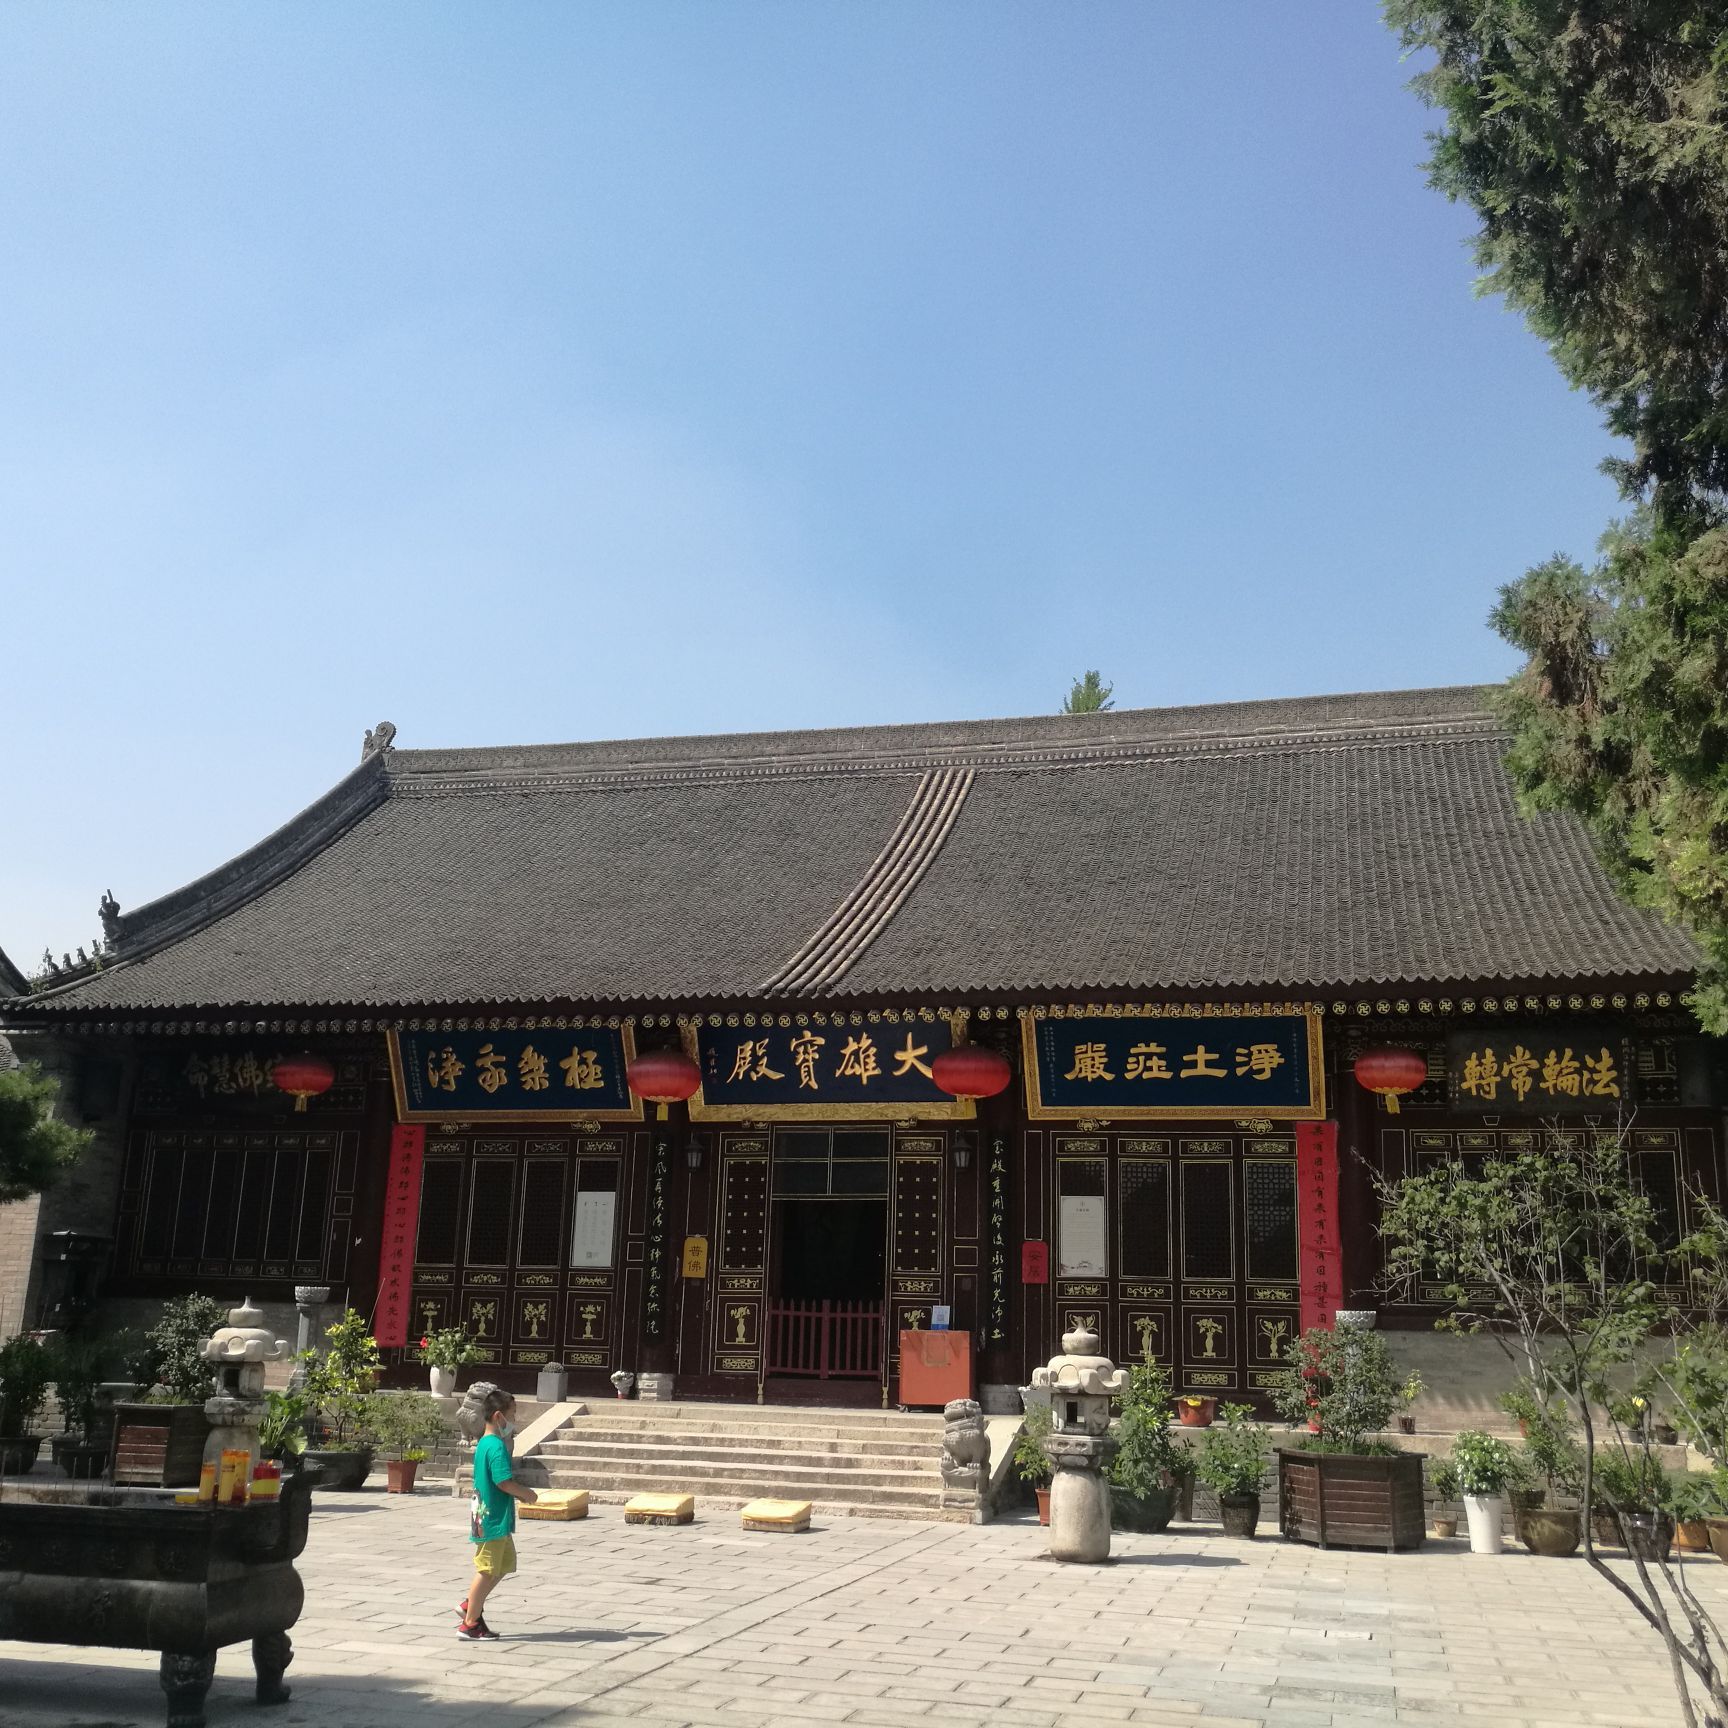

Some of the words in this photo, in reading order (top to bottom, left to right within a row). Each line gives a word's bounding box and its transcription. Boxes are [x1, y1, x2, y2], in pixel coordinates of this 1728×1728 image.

[726, 1030, 933, 1090] 大雄寶殿
[1460, 1044, 1621, 1103] 法輪常轉
[688, 1244, 703, 1272] 普佛
